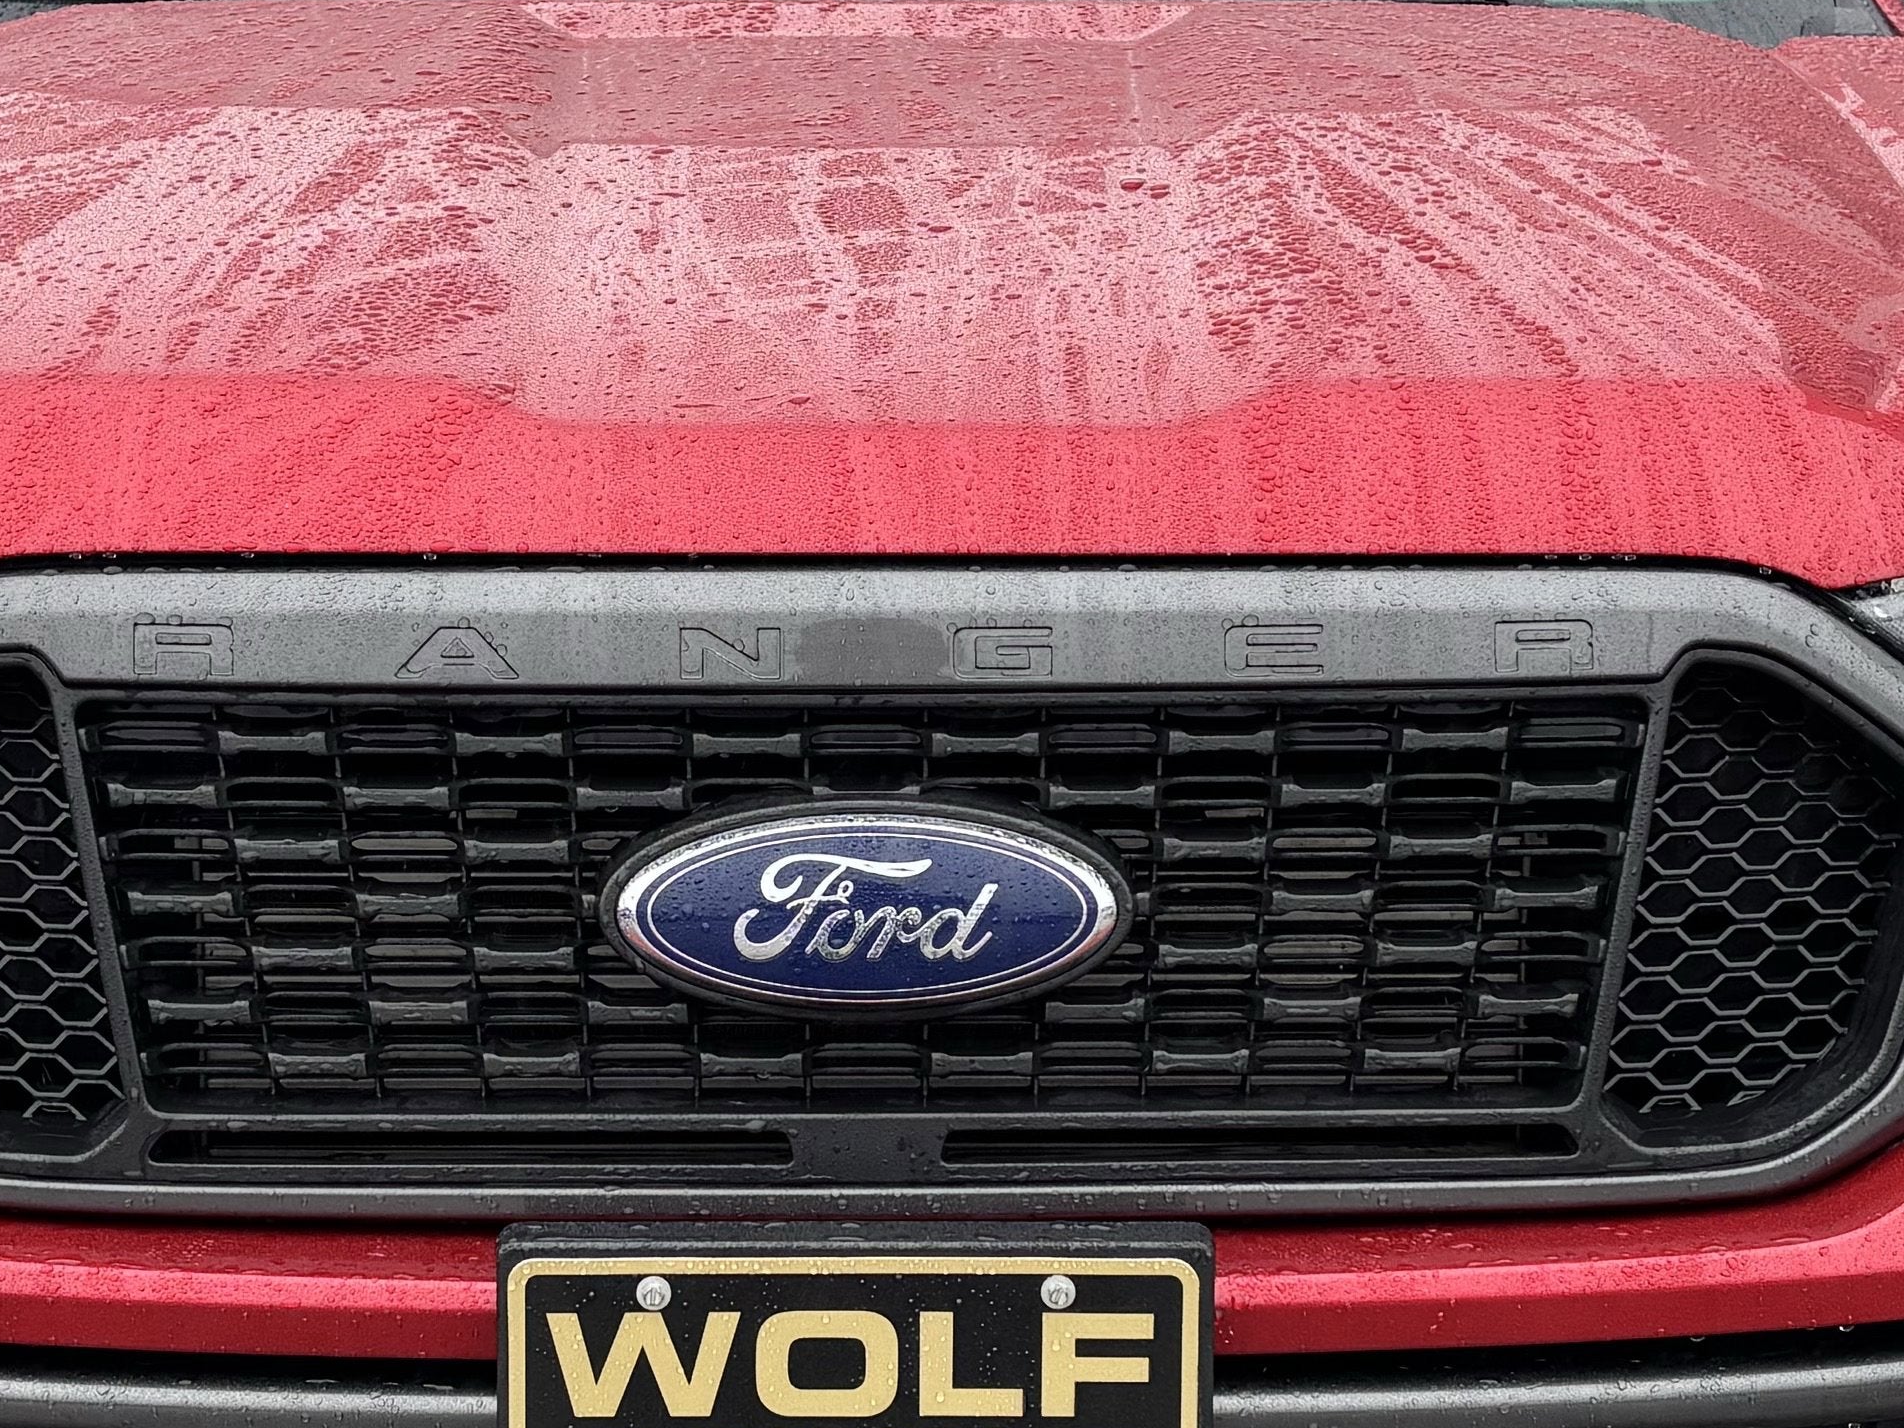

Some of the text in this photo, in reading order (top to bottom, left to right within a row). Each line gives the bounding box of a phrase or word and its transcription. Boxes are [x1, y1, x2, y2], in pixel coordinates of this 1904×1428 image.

[133, 619, 1594, 680] RANGER
[733, 852, 999, 961] Ford
[545, 1310, 1156, 1419] WOLF
